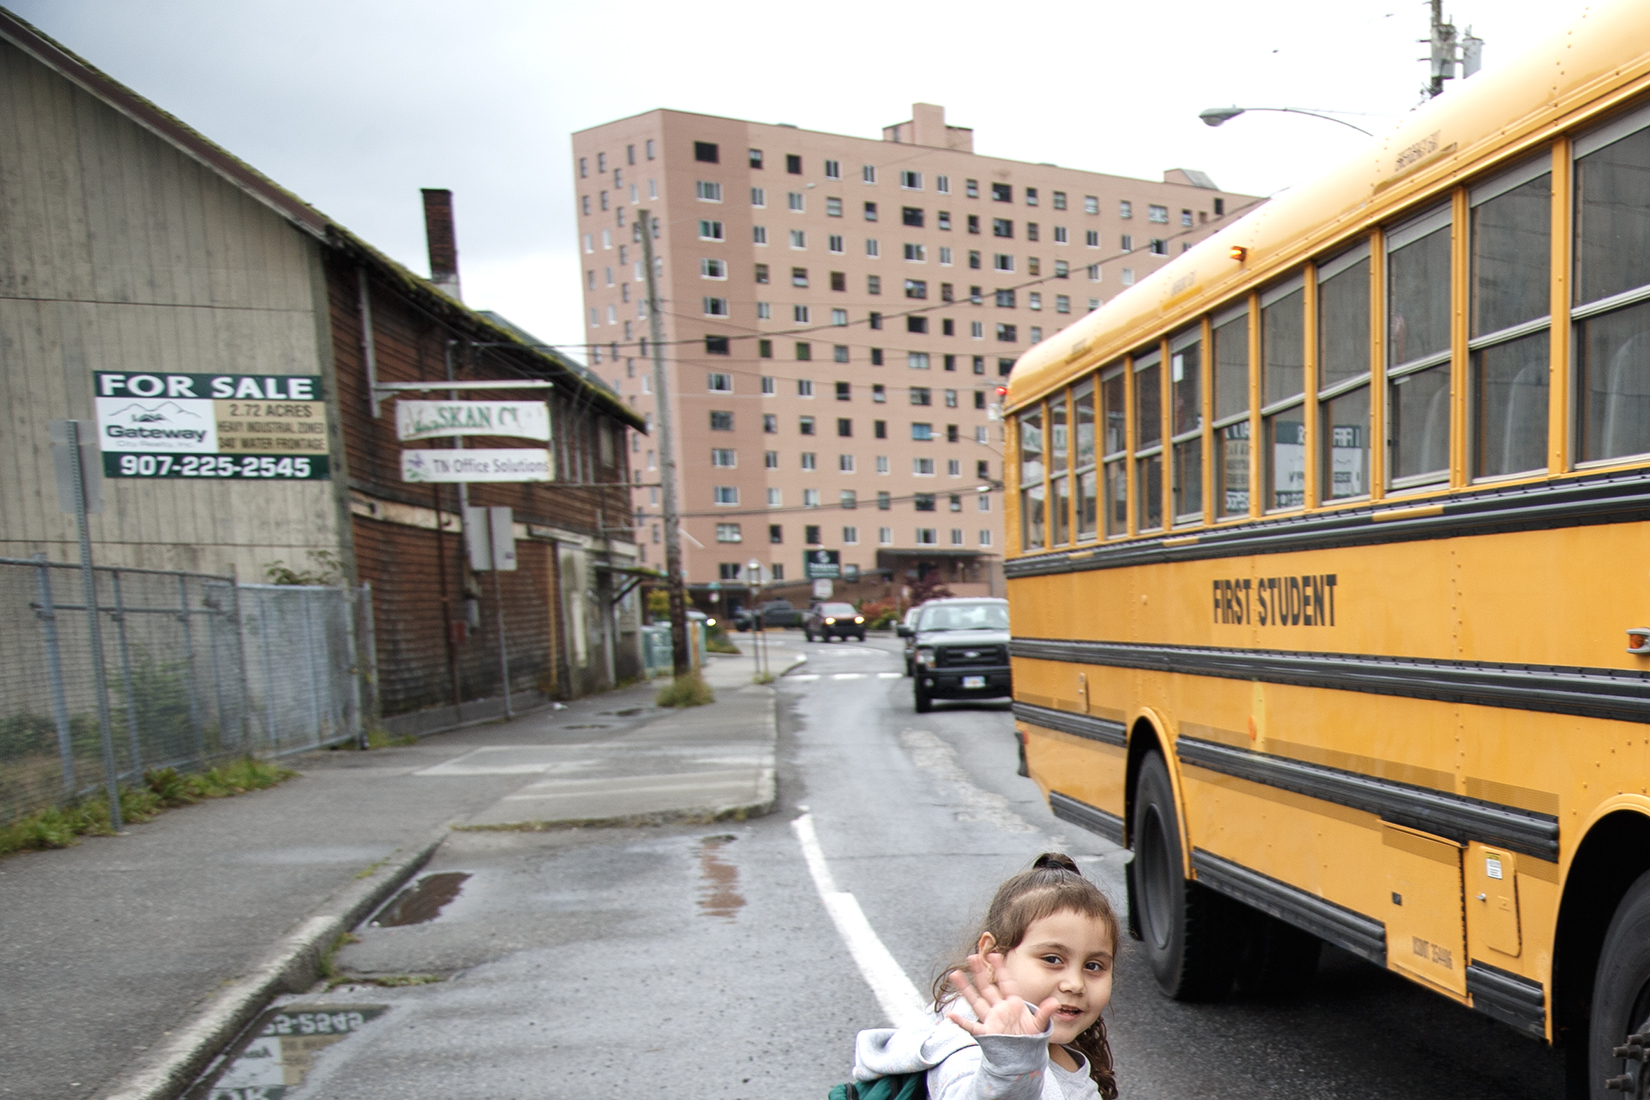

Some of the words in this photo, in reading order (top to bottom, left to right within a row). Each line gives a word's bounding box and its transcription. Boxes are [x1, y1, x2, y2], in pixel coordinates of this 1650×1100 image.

[100, 374, 198, 398] FOR
[211, 376, 314, 400] SALE
[230, 403, 261, 418] 2.72
[265, 404, 312, 418] ACRES
[106, 425, 208, 443] Gateway
[247, 422, 296, 434] INDUSTRIAL
[242, 437, 273, 449] WATER
[276, 438, 326, 450] FRONTAGE
[120, 455, 312, 478] 907-225-2545
[454, 458, 490, 473] Office
[493, 458, 549, 473] Solutions
[1213, 578, 1252, 625] FIRST
[1258, 574, 1337, 626] STUDENT
